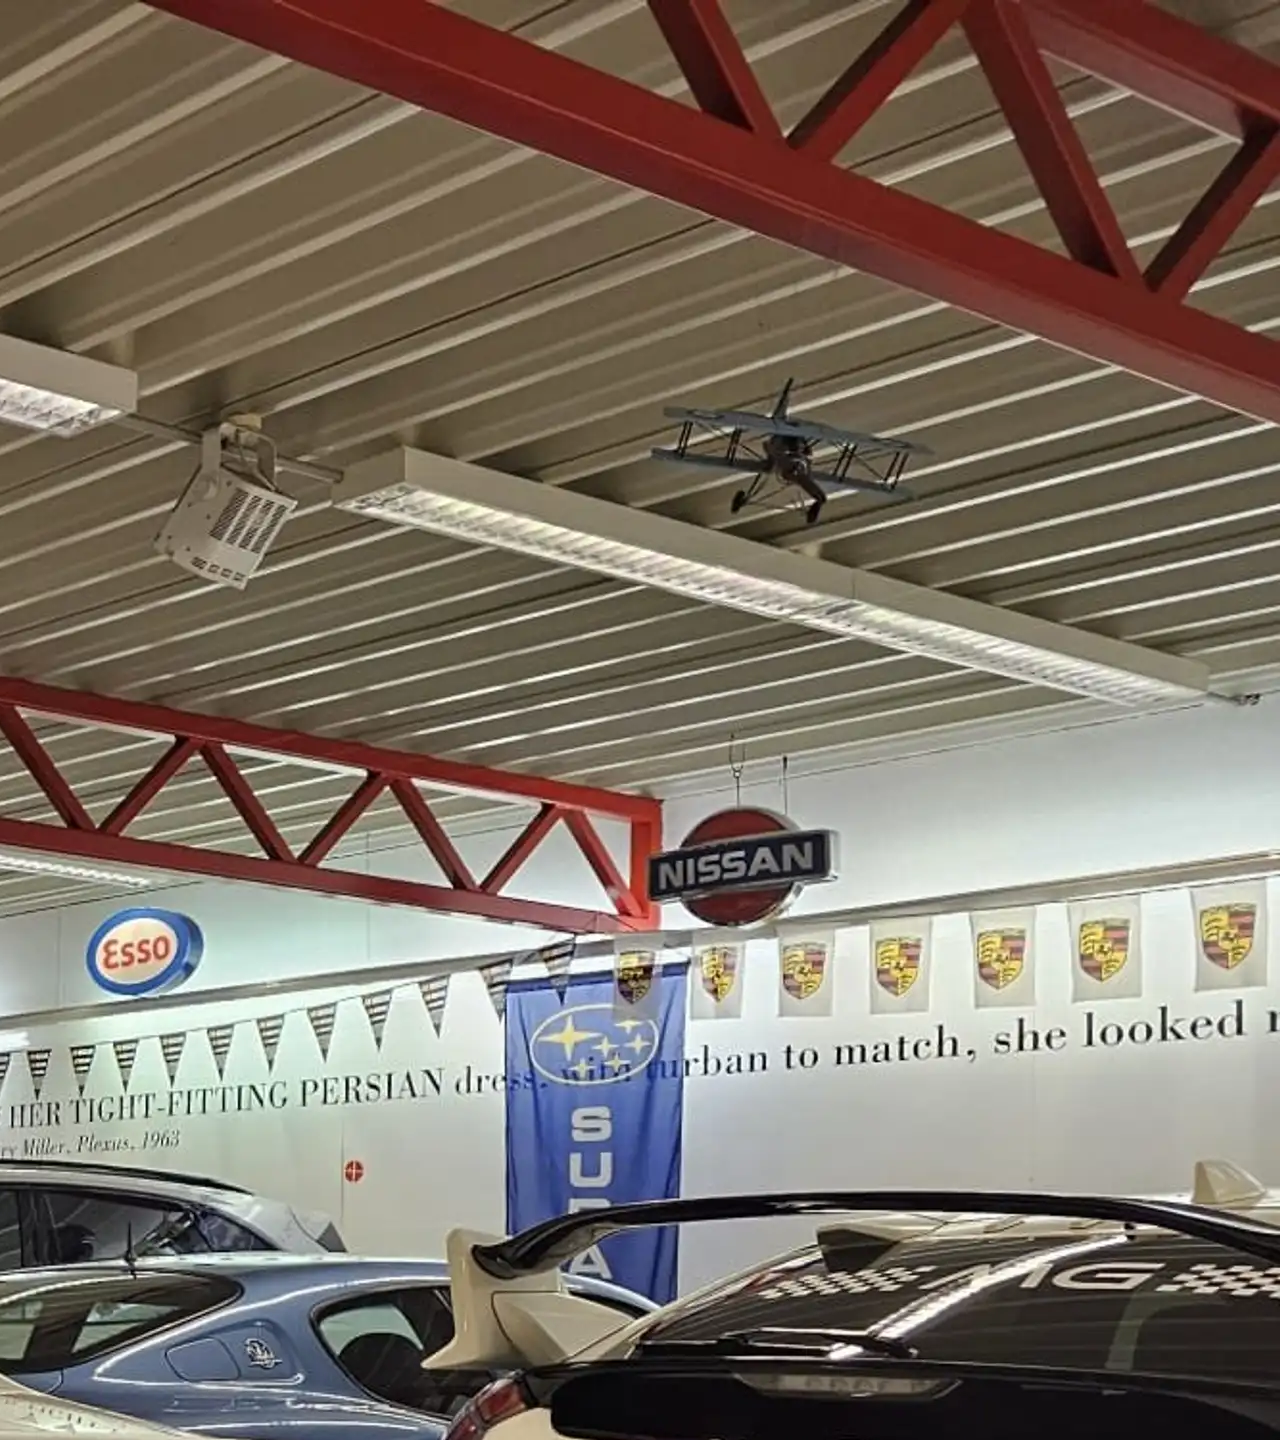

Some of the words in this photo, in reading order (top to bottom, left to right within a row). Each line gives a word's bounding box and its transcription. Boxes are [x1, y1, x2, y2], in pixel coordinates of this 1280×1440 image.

[658, 841, 814, 890] NISSAN
[9, 1101, 61, 1129] HER
[69, 1080, 288, 1124] TIGHT-FITTING
[301, 1066, 445, 1107] PERSIAN
[783, 1046, 819, 1070] to
[834, 1023, 977, 1066] match,
[993, 1017, 1067, 1055] she
[1082, 998, 1249, 1048] looked
[141, 1129, 181, 1149] 1963
